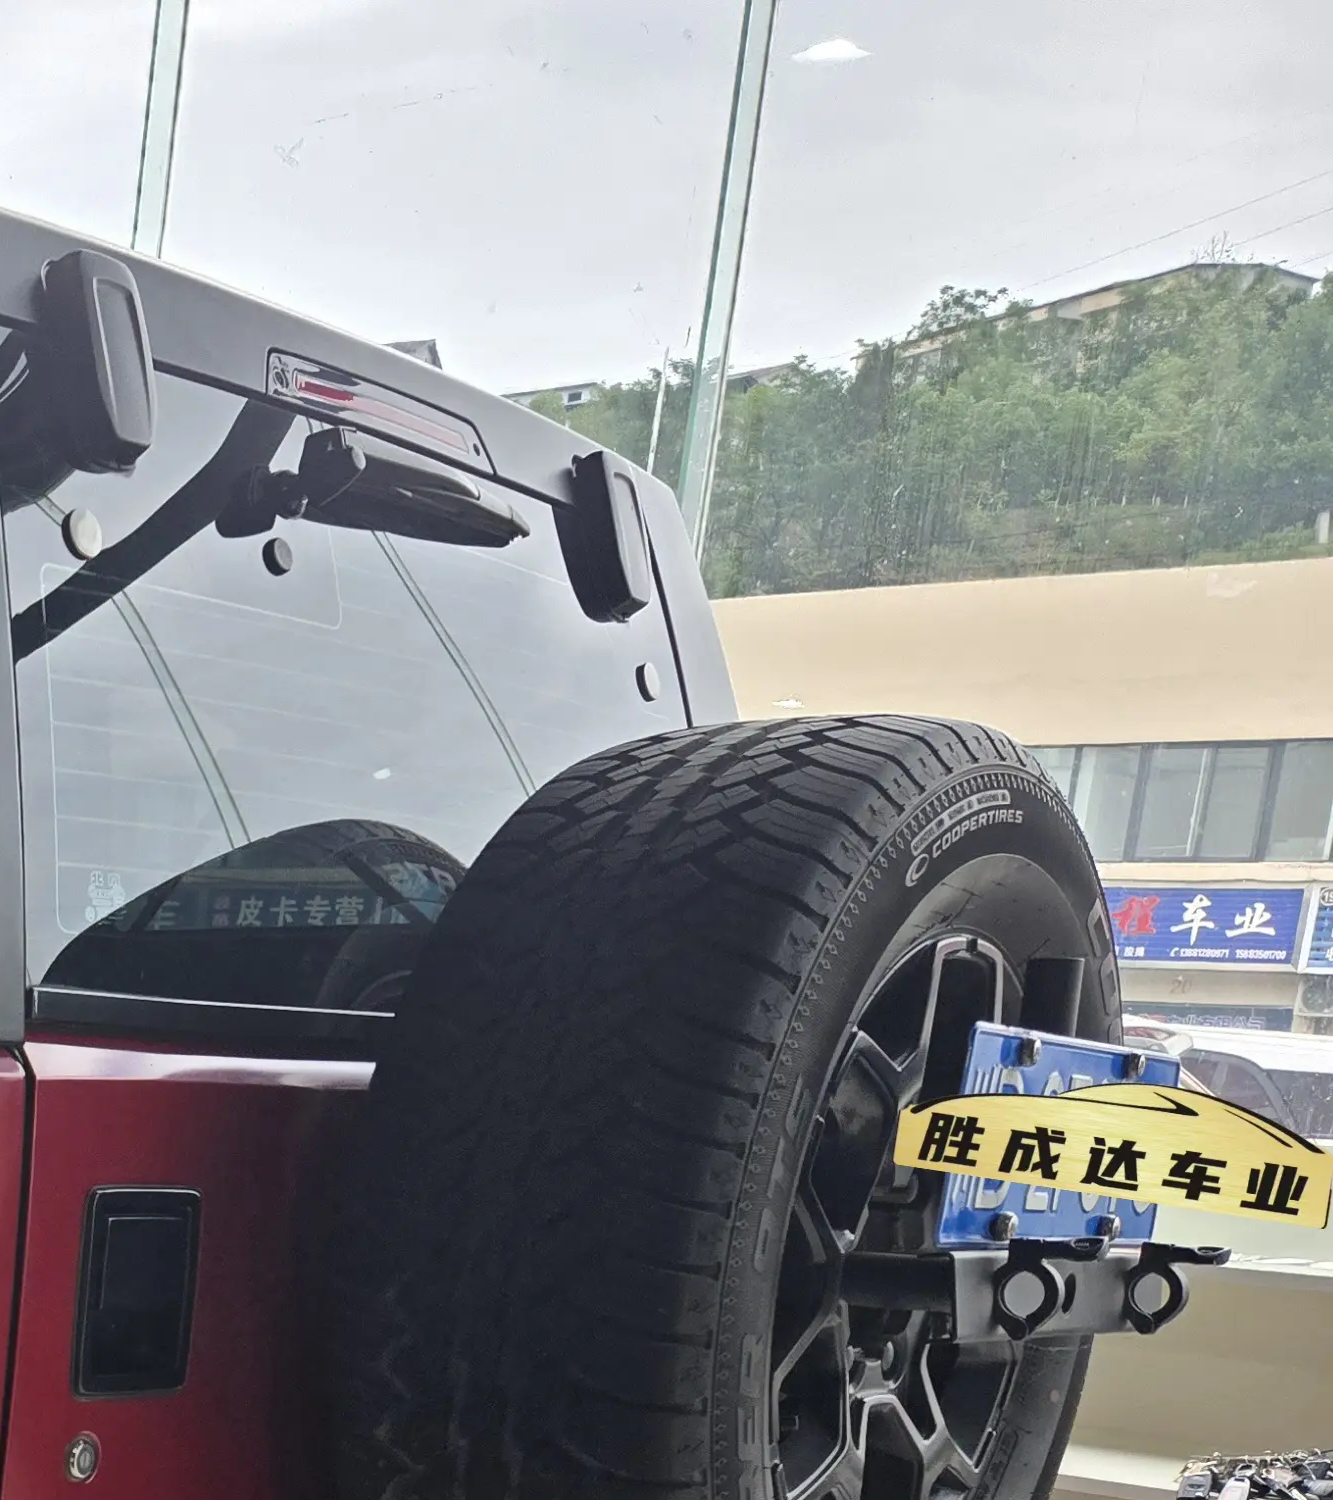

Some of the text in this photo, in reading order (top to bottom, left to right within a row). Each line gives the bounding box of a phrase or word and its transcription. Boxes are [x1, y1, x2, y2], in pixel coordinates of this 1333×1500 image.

[917, 1112, 1309, 1216] 胜成达车业
